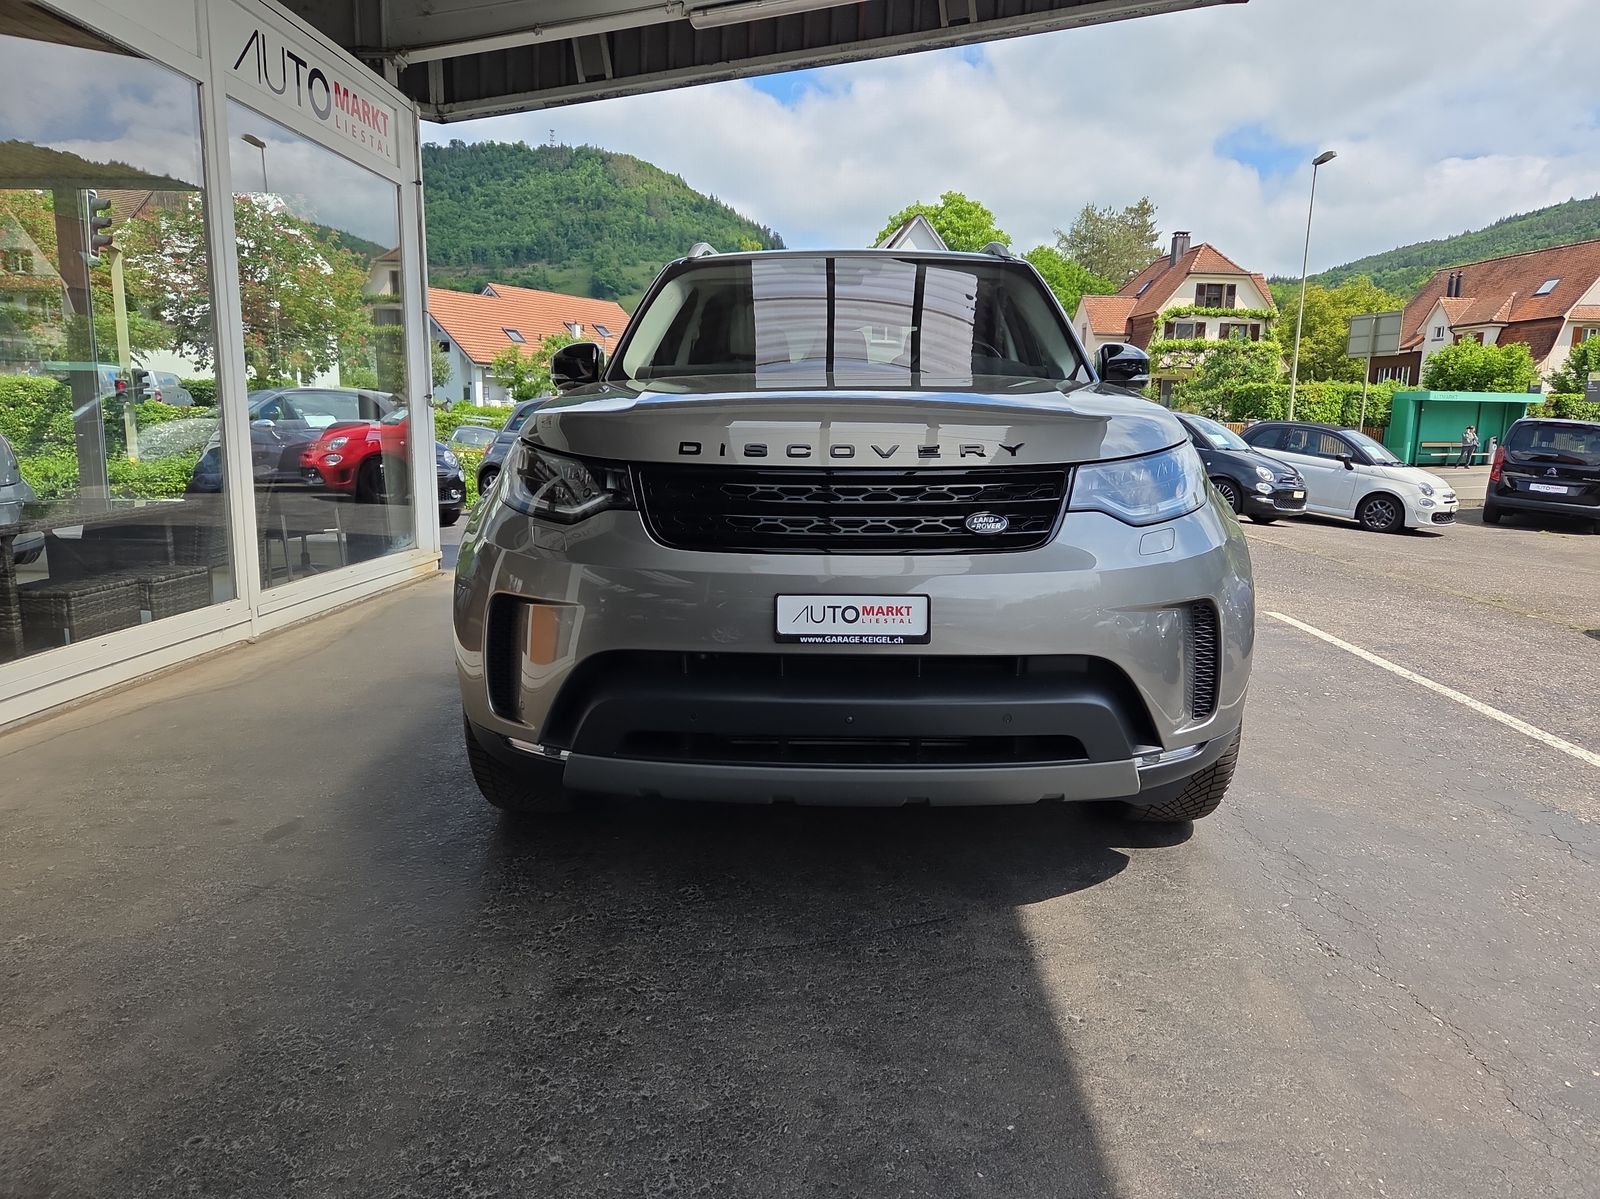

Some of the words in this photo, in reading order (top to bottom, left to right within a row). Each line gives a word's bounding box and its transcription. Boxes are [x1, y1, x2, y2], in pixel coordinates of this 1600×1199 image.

[335, 115, 391, 158] LIESTAL
[678, 441, 1026, 460] DISCOVERY
[800, 635, 904, 644] www.GARAGE-KEIGEL.ch
